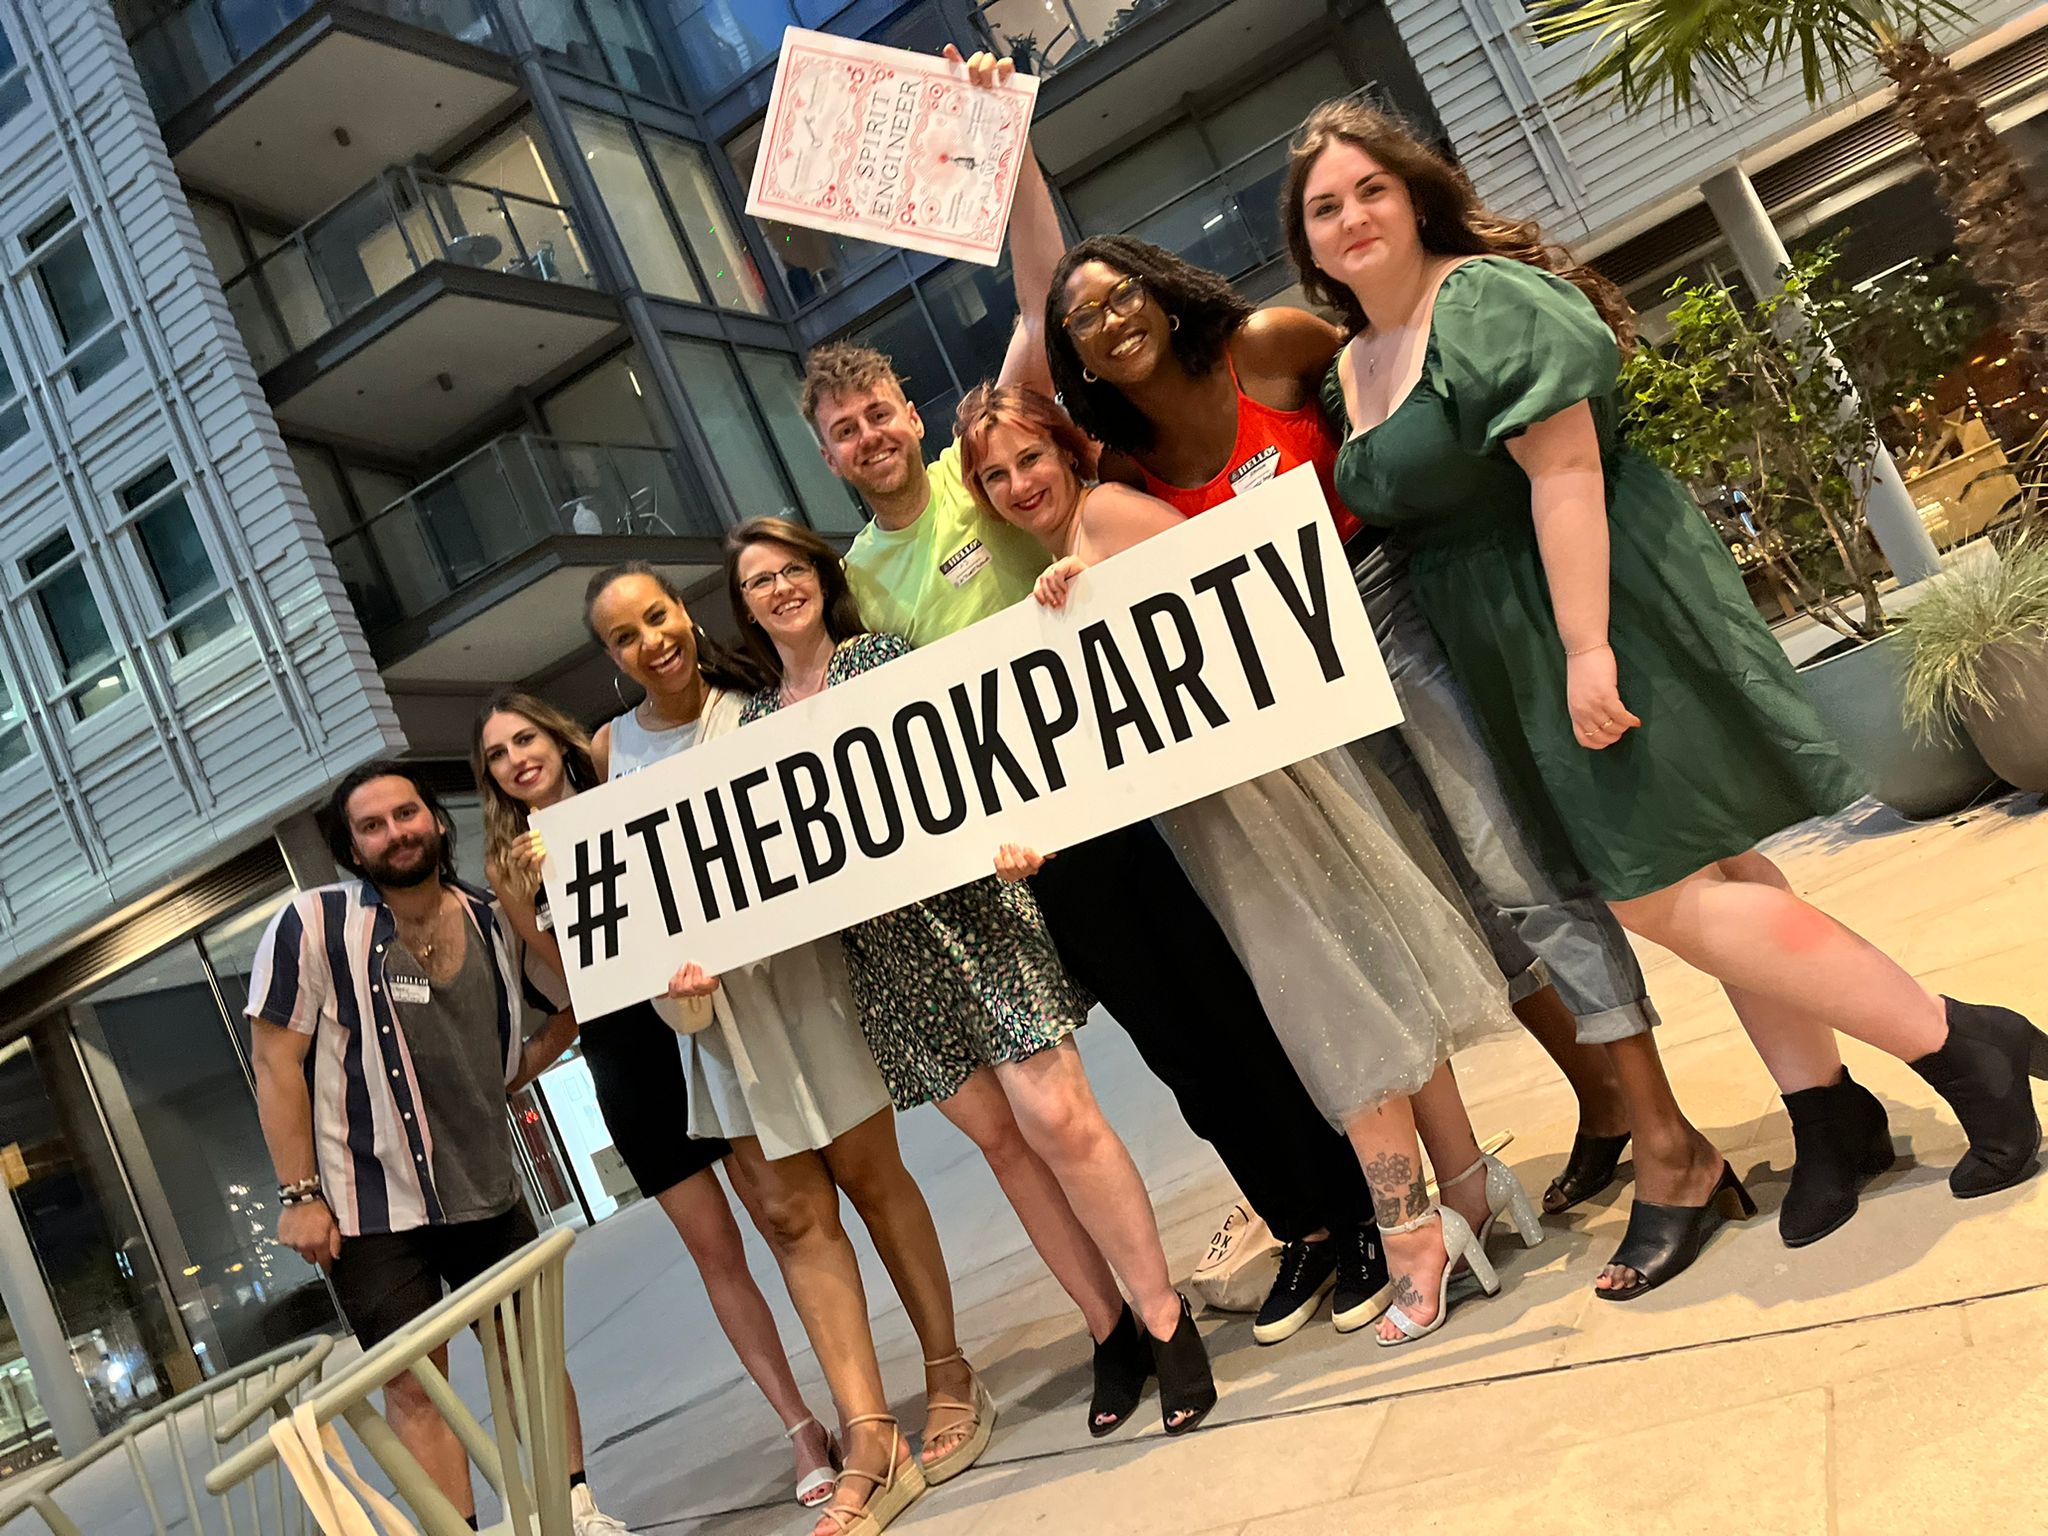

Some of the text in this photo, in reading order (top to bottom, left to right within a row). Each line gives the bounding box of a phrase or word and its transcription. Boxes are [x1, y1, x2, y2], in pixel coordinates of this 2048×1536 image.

[856, 90, 890, 179] SPIRIT
[872, 80, 921, 218] ENGINEER
[566, 522, 1344, 968] #THEBOOKPARTY
